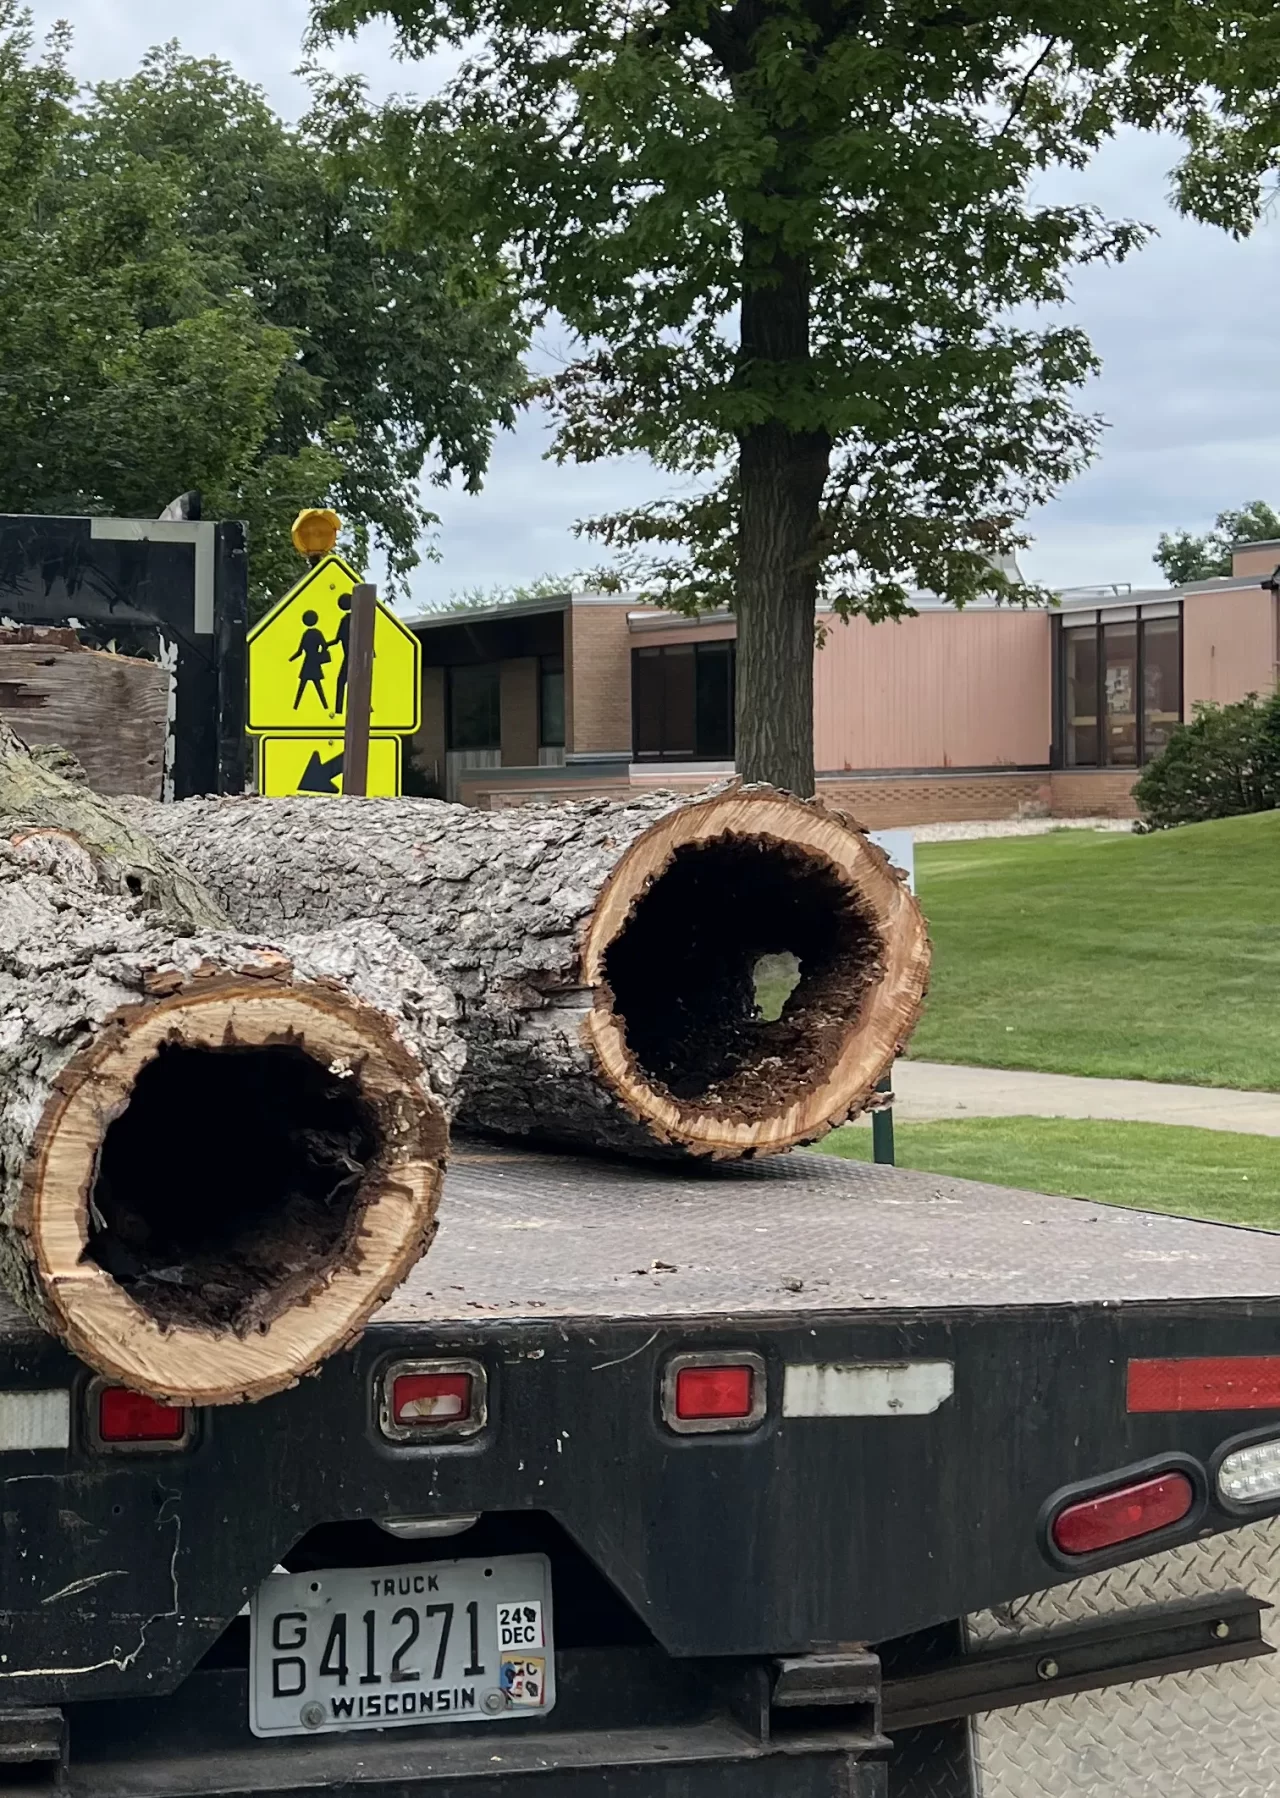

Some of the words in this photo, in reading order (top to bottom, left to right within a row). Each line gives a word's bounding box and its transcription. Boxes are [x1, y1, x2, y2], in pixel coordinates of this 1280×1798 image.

[371, 1574, 440, 1597] TRUCK
[500, 1607, 522, 1625] 24
[319, 1601, 486, 1686] 41271
[501, 1625, 535, 1645] DEC
[330, 1687, 475, 1718] WISCONSIN
